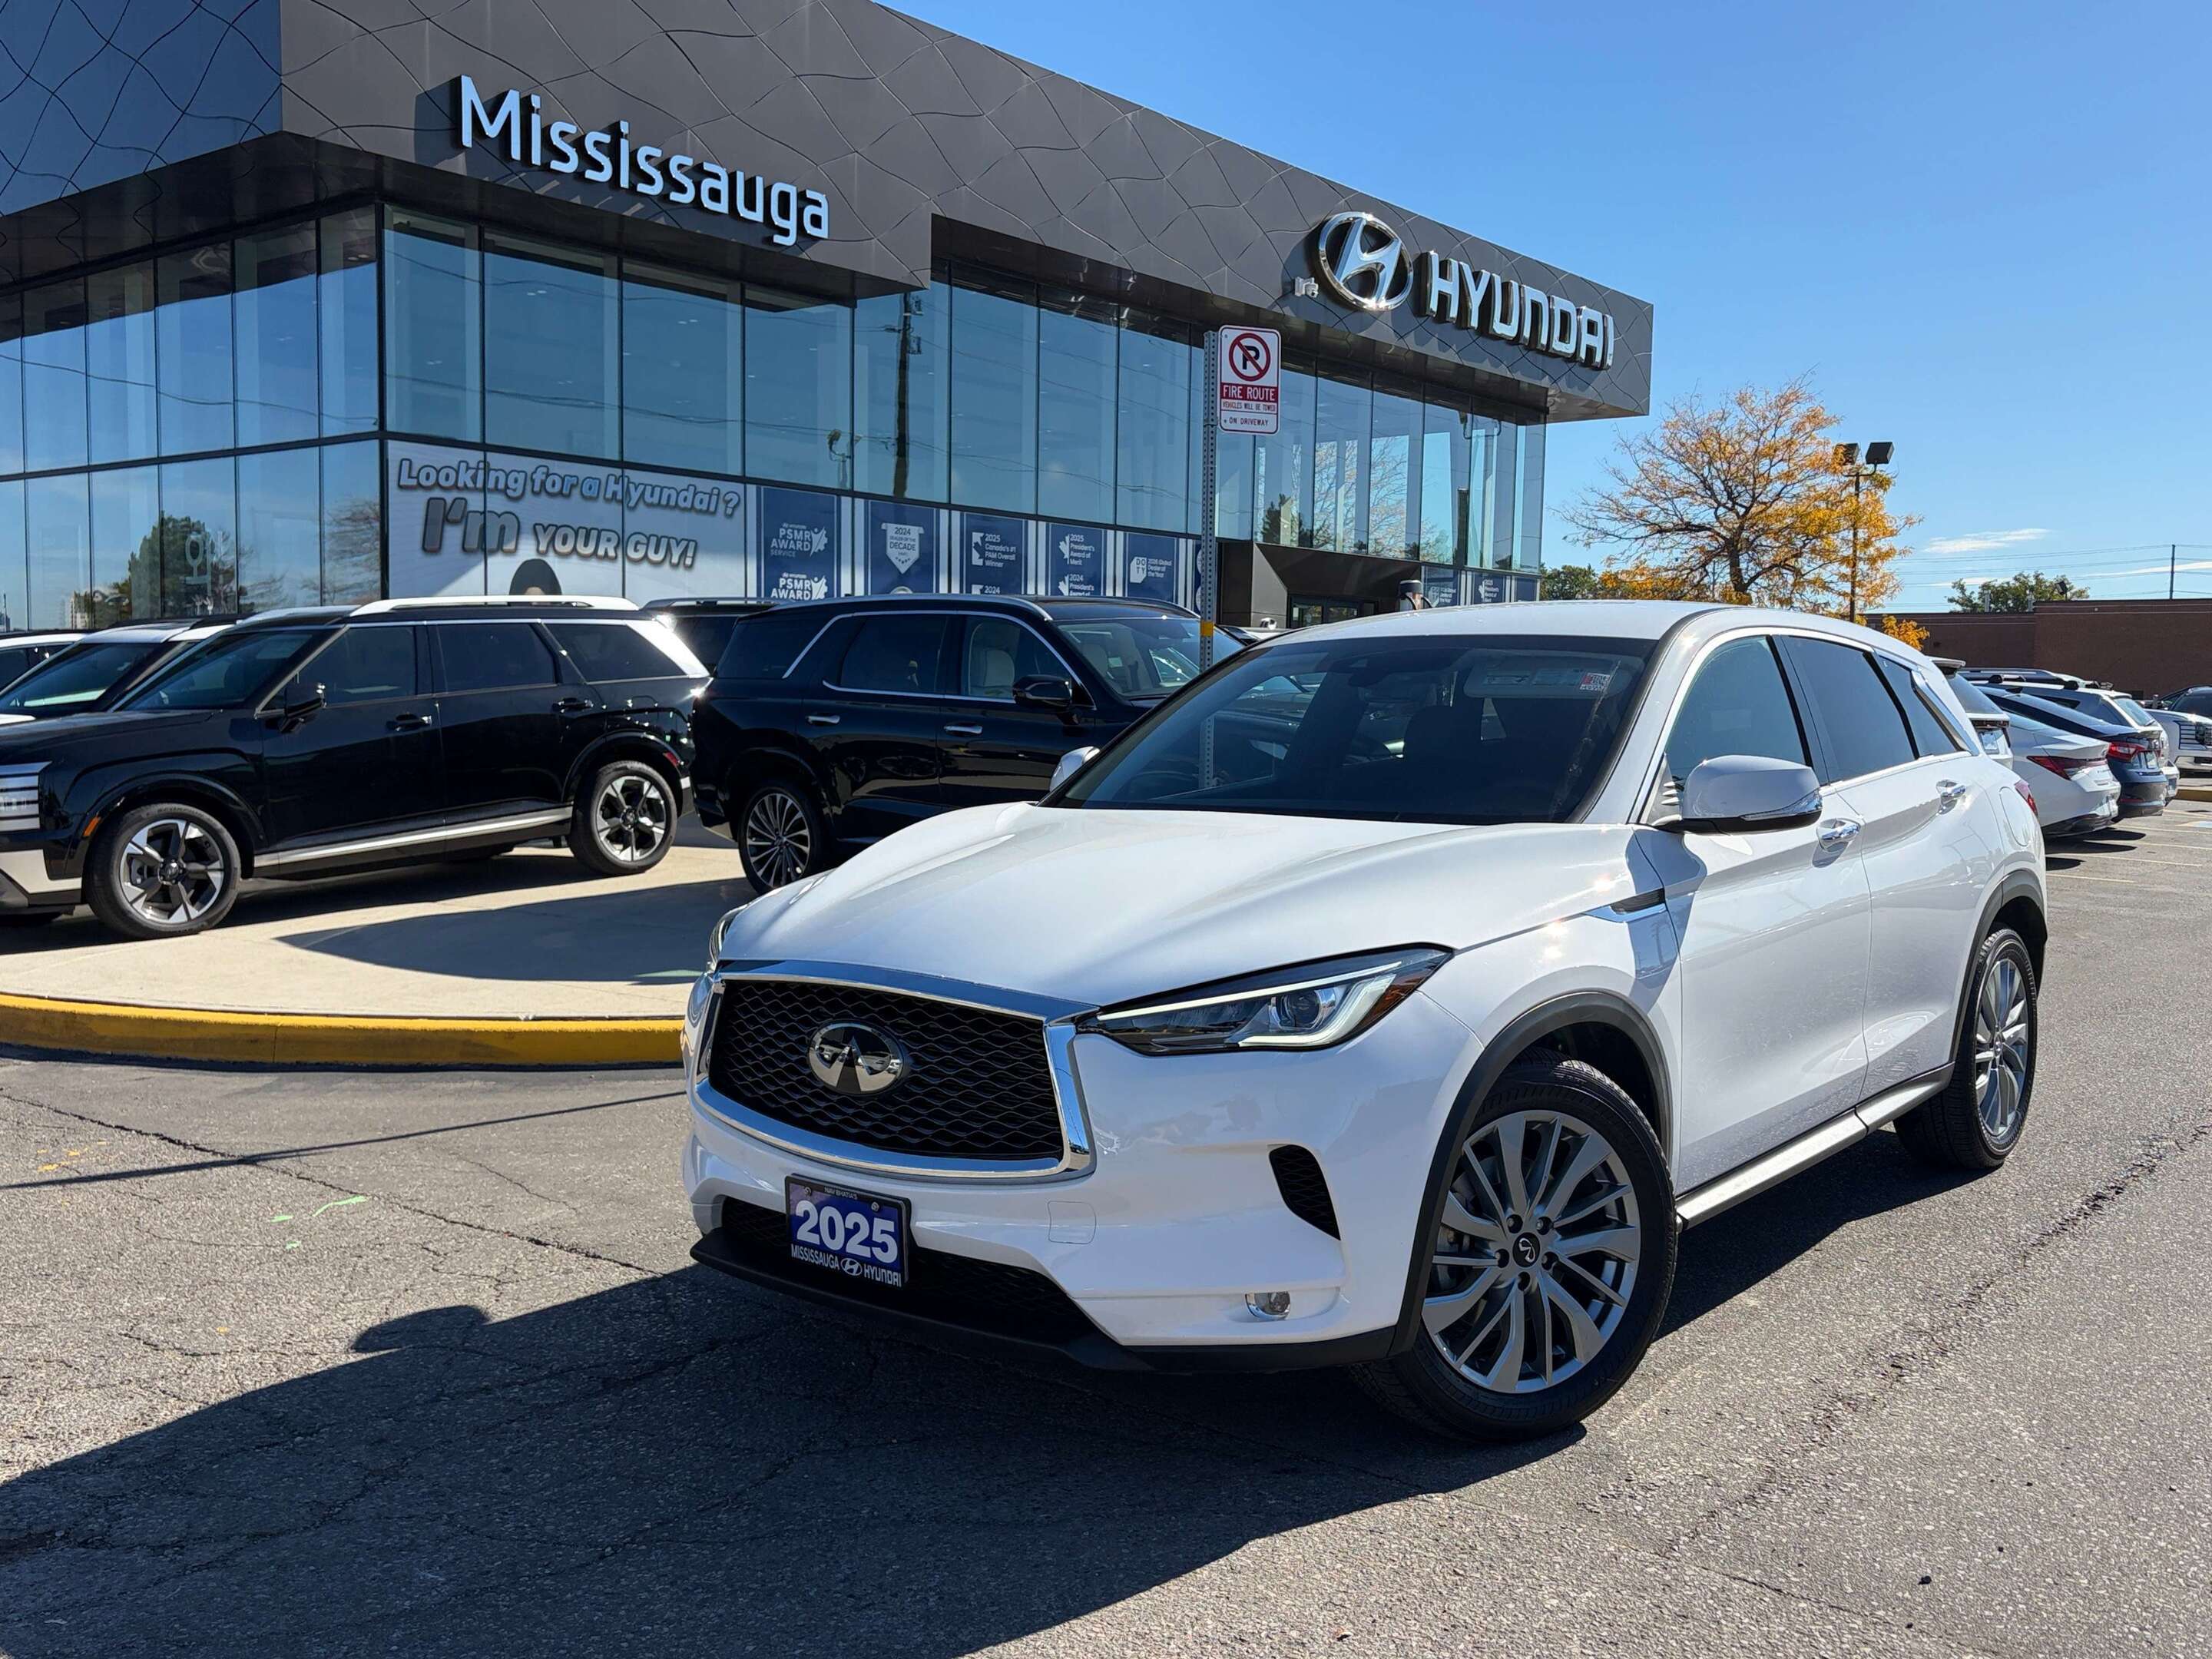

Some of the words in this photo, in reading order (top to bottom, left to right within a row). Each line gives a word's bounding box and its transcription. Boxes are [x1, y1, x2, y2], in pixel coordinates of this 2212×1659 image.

[460, 75, 830, 246] Mississauga
[1426, 250, 1614, 370] HYUNDAI
[1223, 385, 1243, 399] FIRE
[1247, 386, 1276, 401] ROUTE
[1223, 401, 1243, 409] VEHICLES
[397, 458, 527, 499] Looking
[531, 465, 578, 497] for
[581, 476, 601, 499] a
[422, 496, 521, 554] I'm
[533, 523, 621, 559] YOUR
[625, 532, 697, 568] GUY!
[779, 528, 811, 541] PSMR
[894, 527, 912, 535] 2024
[985, 533, 1001, 542] 2025
[770, 538, 811, 551] AWARD
[1070, 534, 1084, 542] 2025
[889, 541, 916, 551] DECADE
[779, 578, 811, 591] PSMR
[984, 585, 1001, 594] 2024
[770, 588, 811, 601] AWARD
[796, 1200, 898, 1263] 2025
[791, 1243, 841, 1271] MISSISSAUGA
[863, 1263, 902, 1288] HYUNDAI
